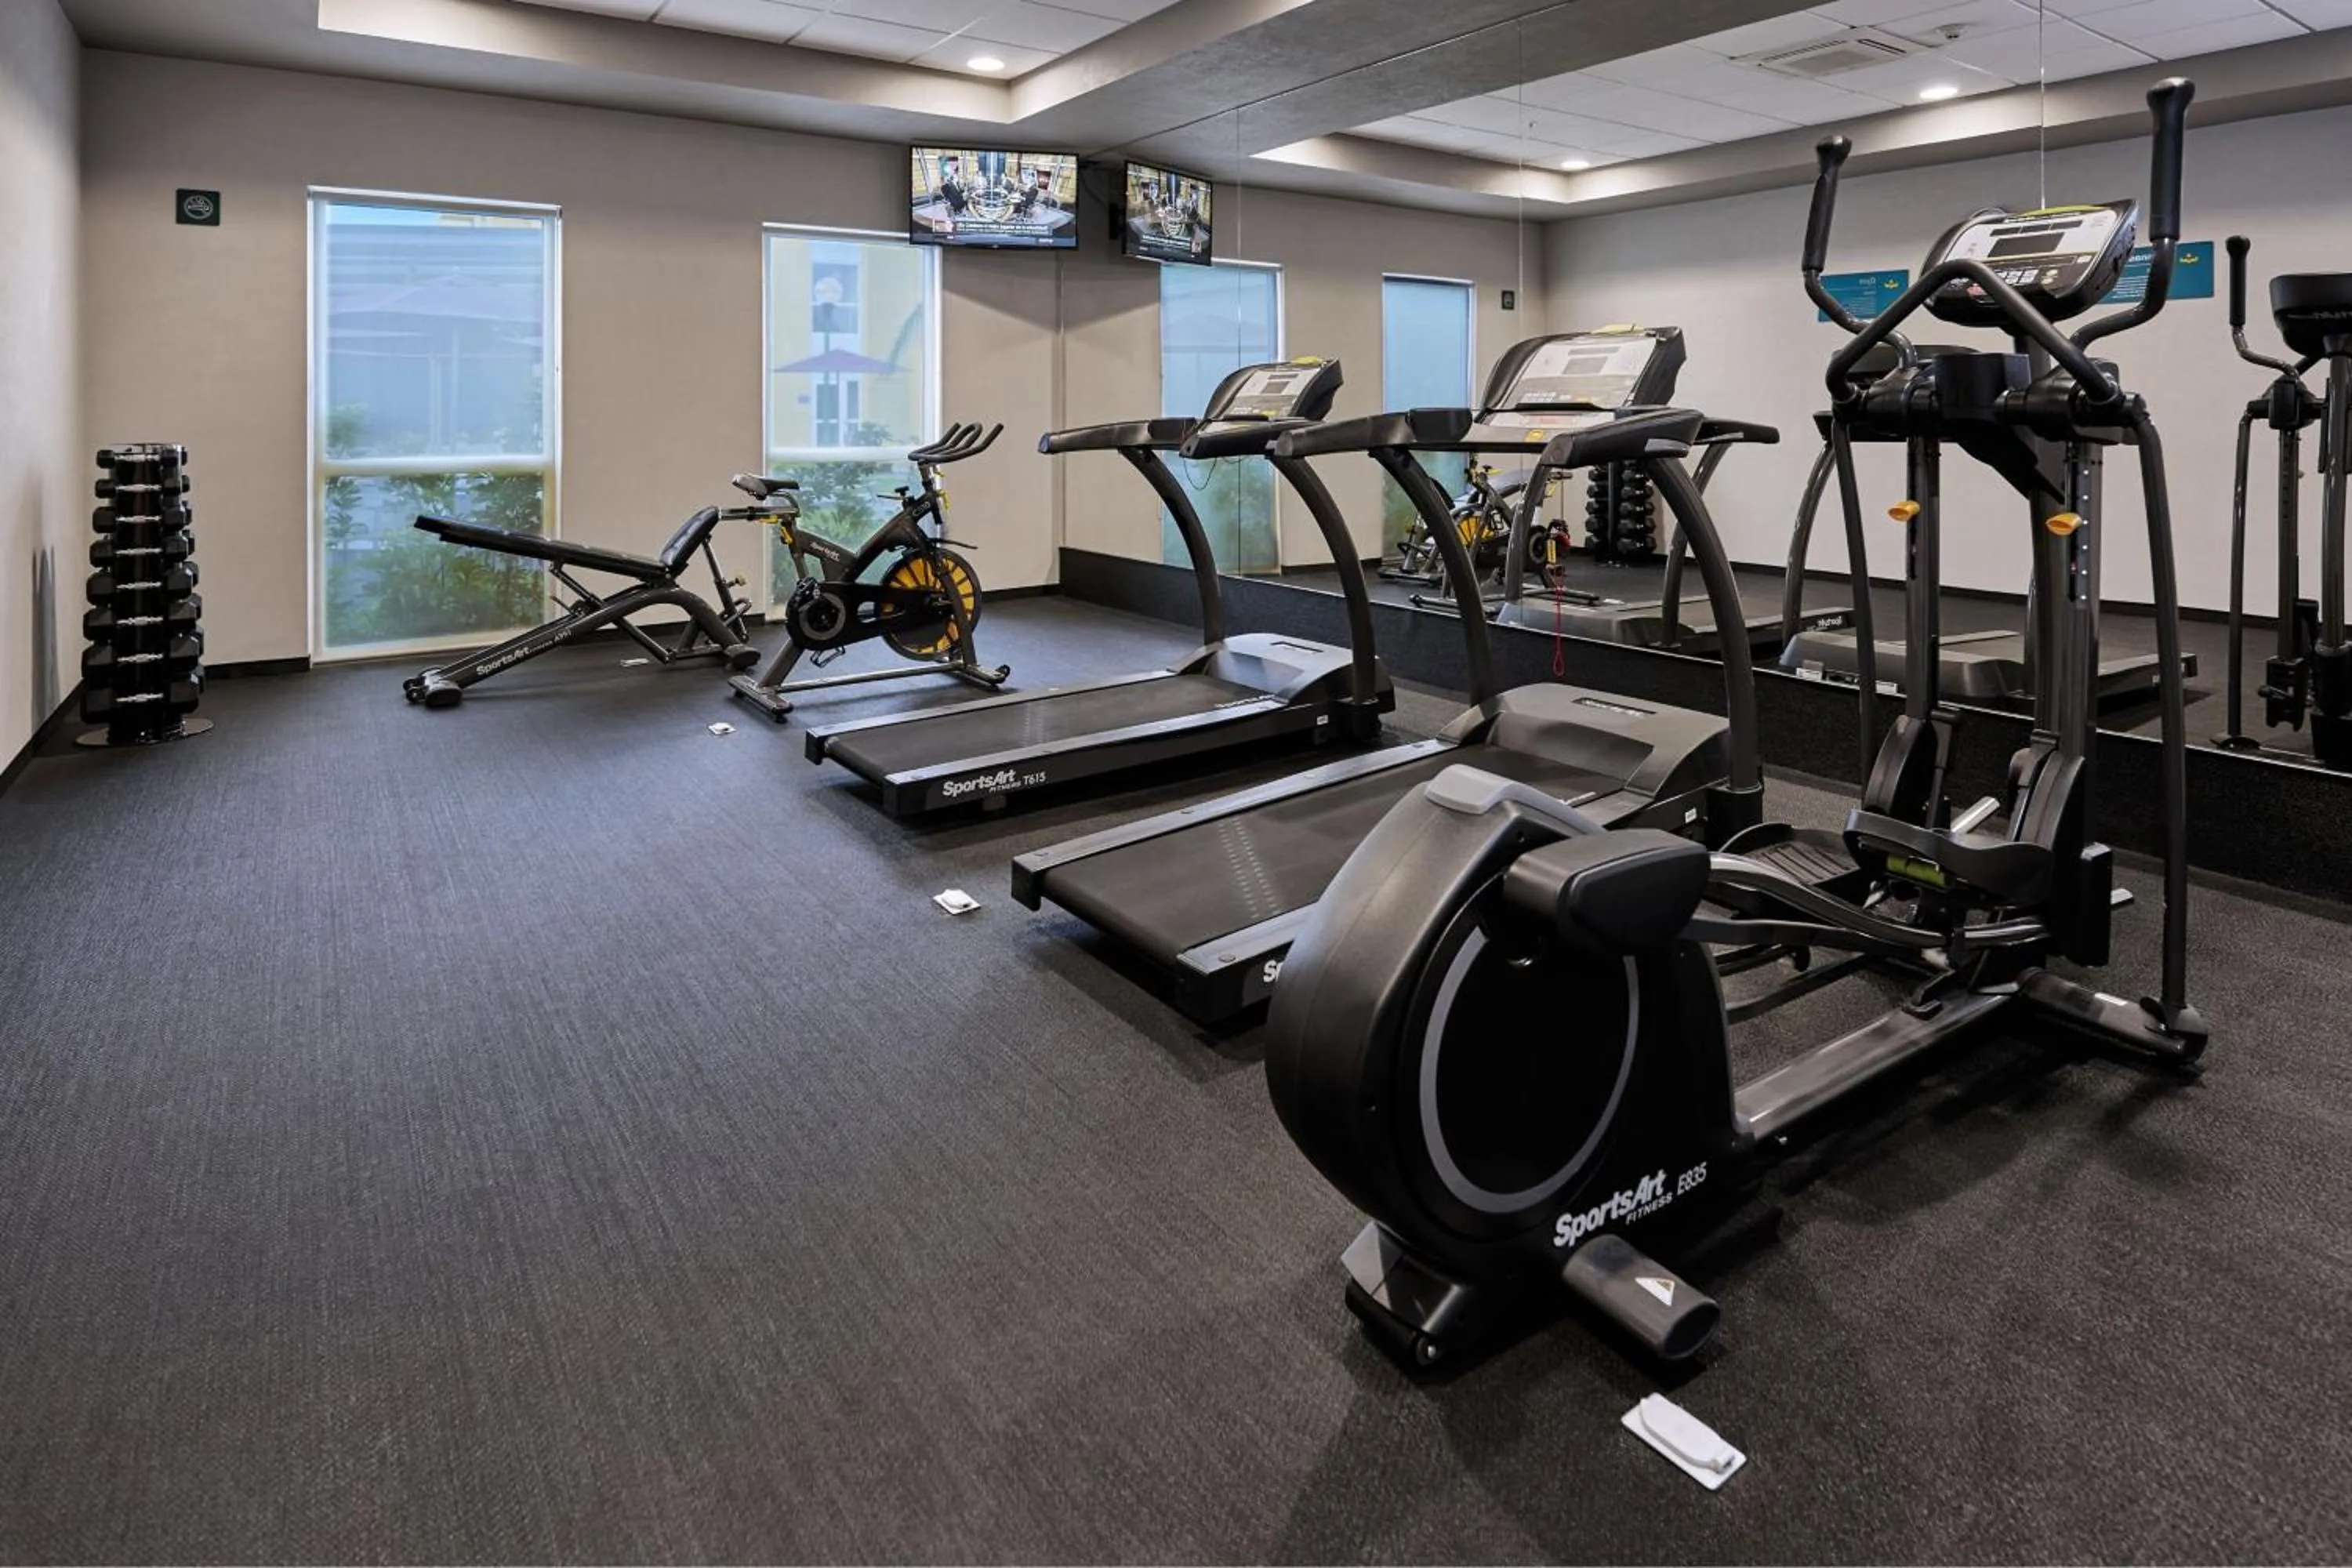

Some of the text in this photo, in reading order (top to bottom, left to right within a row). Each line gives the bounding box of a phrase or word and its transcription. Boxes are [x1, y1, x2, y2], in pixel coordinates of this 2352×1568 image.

[476, 647, 530, 675] SportsArt
[942, 769, 1046, 797] SportsArt T615
[1553, 1161, 1707, 1247] SportsArt E835
[1625, 1192, 1673, 1225] FITNESS
